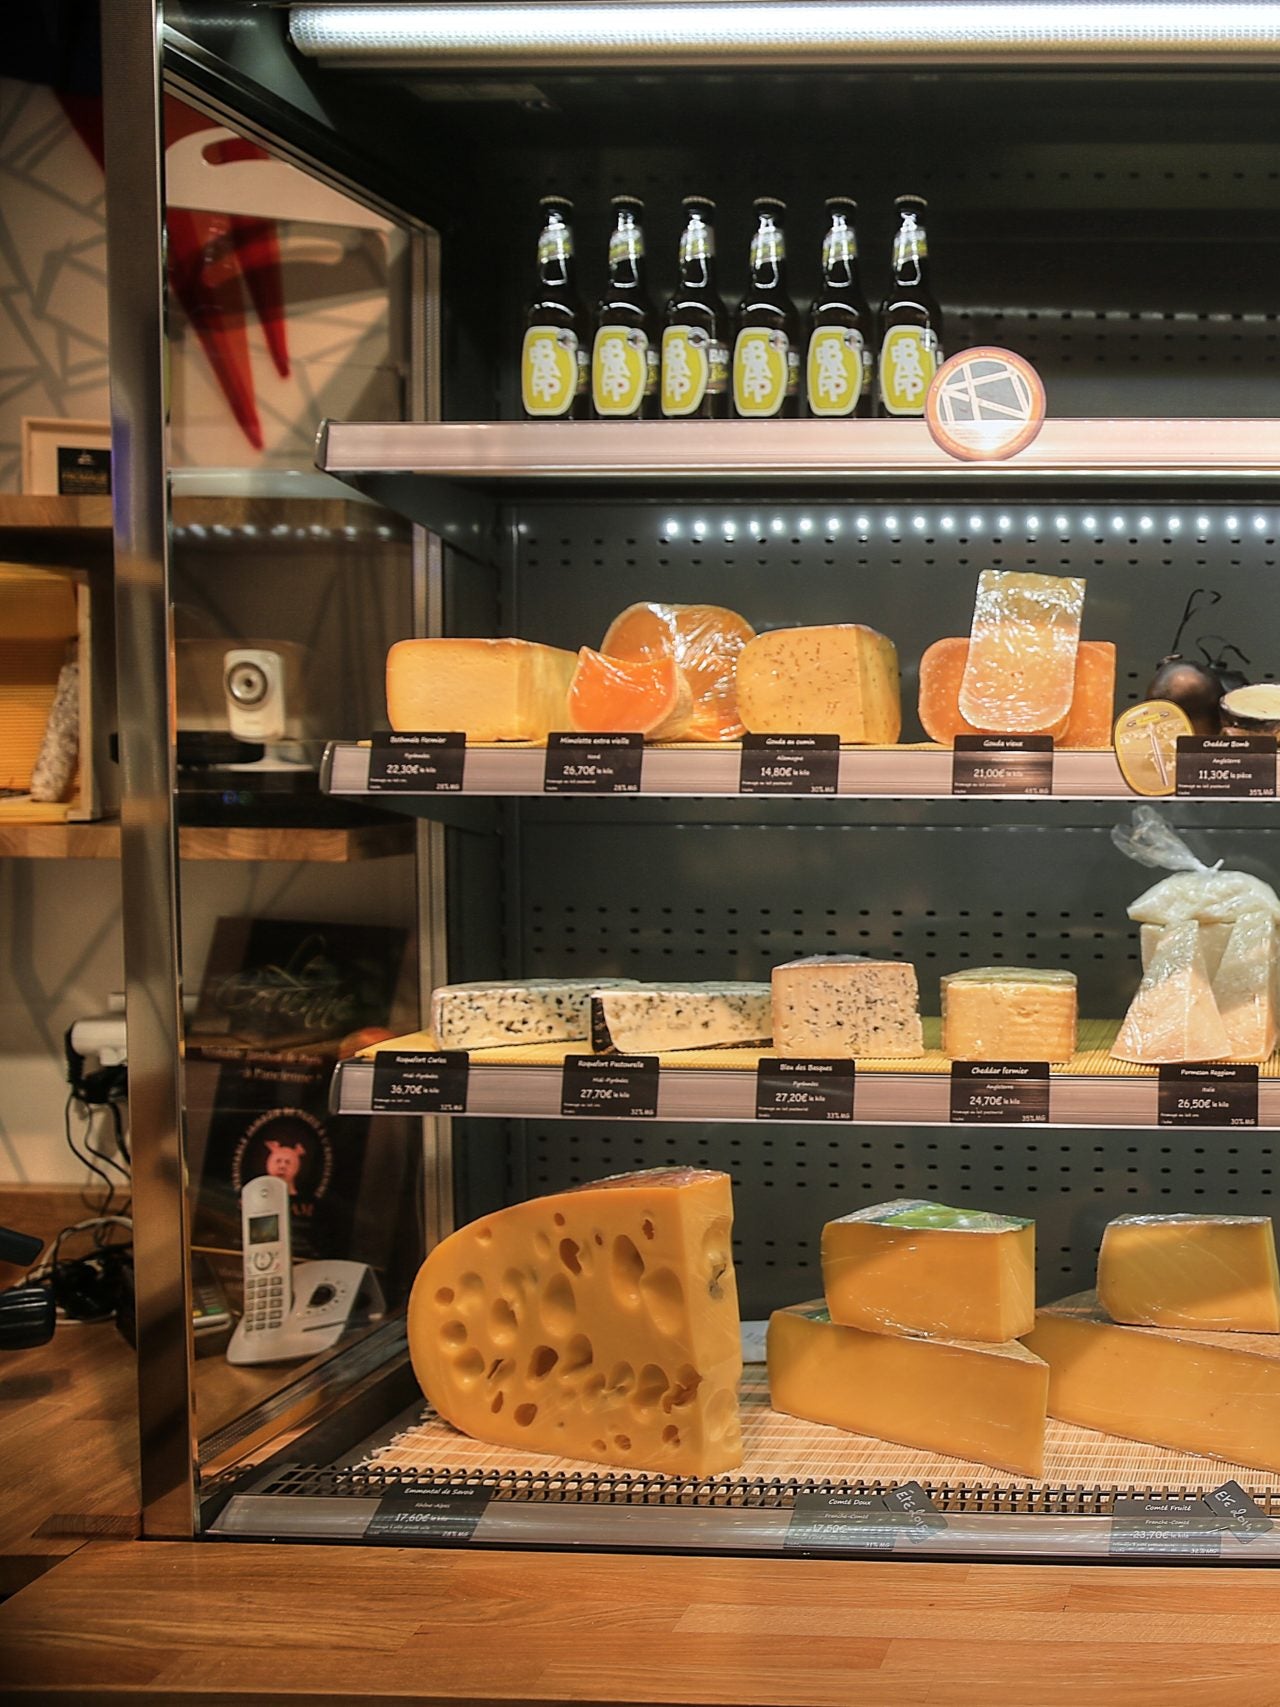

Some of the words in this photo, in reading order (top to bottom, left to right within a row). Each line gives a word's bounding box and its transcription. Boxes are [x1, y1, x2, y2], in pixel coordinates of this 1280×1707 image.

[387, 764, 418, 774] 22,30€
[563, 766, 595, 776] 26,70€
[761, 767, 792, 777] 14,80€
[974, 769, 1004, 778] 21,00€
[1199, 770, 1229, 781] 11,30€
[396, 1056, 426, 1064] Roquefort
[578, 1060, 608, 1068] Roquefort
[808, 1064, 832, 1072] Basques
[391, 1085, 422, 1094] 36,70€
[581, 1089, 612, 1099] 27,70€
[776, 1093, 807, 1103] 27,20€
[970, 1096, 1002, 1106] 24,70€
[1178, 1099, 1211, 1109] 26,50€
[395, 1513, 430, 1522] 17,60€
[813, 1524, 847, 1533] 17,50€
[1133, 1531, 1168, 1539] 23,70€
